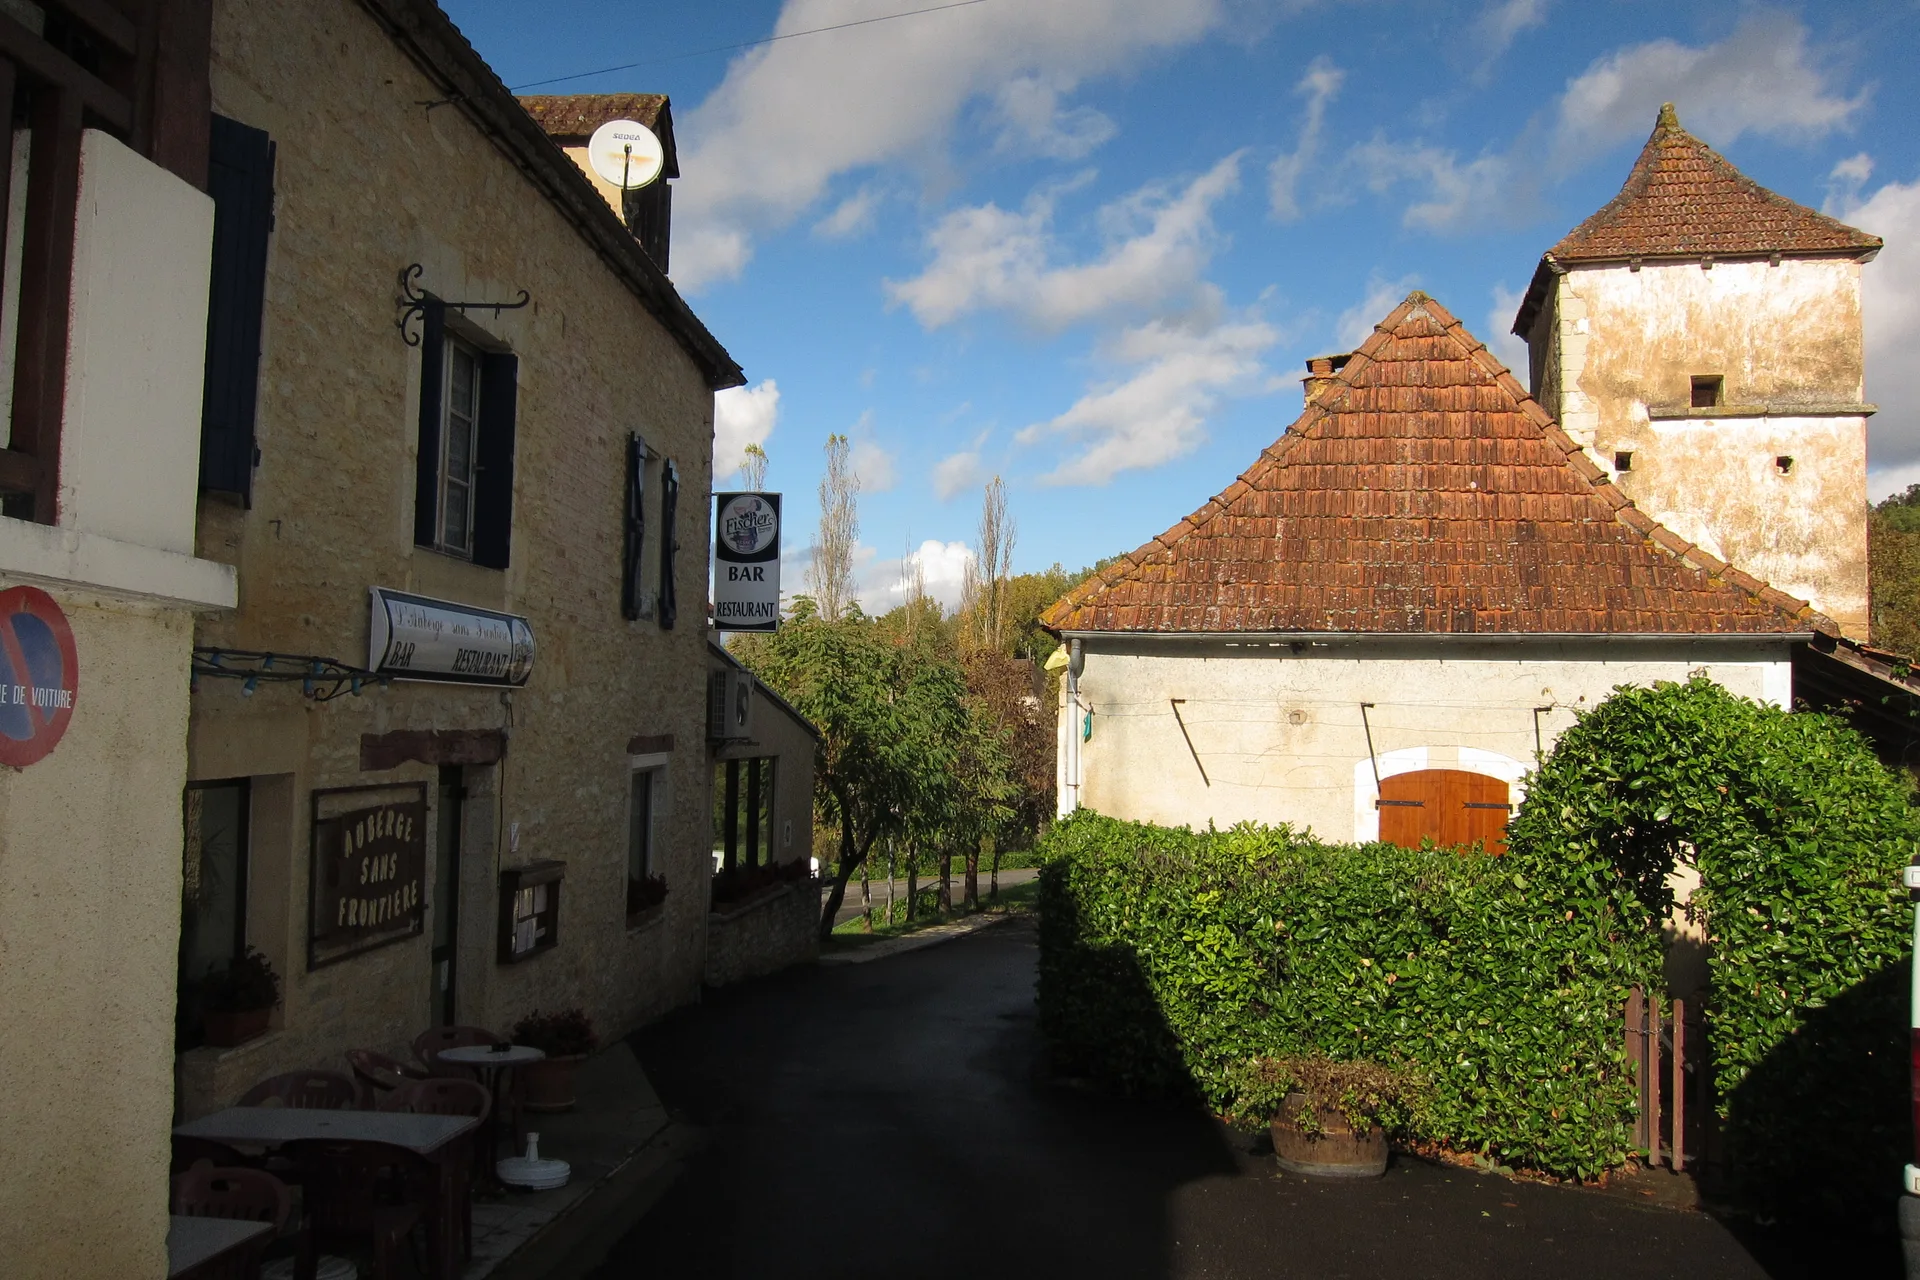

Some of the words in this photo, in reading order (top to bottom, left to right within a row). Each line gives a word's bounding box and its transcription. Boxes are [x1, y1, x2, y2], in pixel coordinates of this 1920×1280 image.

[612, 132, 641, 141] SEDEA
[726, 511, 770, 534] Fischer
[728, 566, 764, 582] BAR
[716, 601, 775, 618] RESTAURANT
[389, 641, 416, 668] BAR
[451, 648, 509, 676] RESTAURANT
[13, 685, 26, 705] DE
[31, 687, 73, 709] VOITURE
[343, 809, 413, 859] AUBERGE
[360, 851, 399, 886] SANS
[337, 879, 419, 929] FRONTIERE
